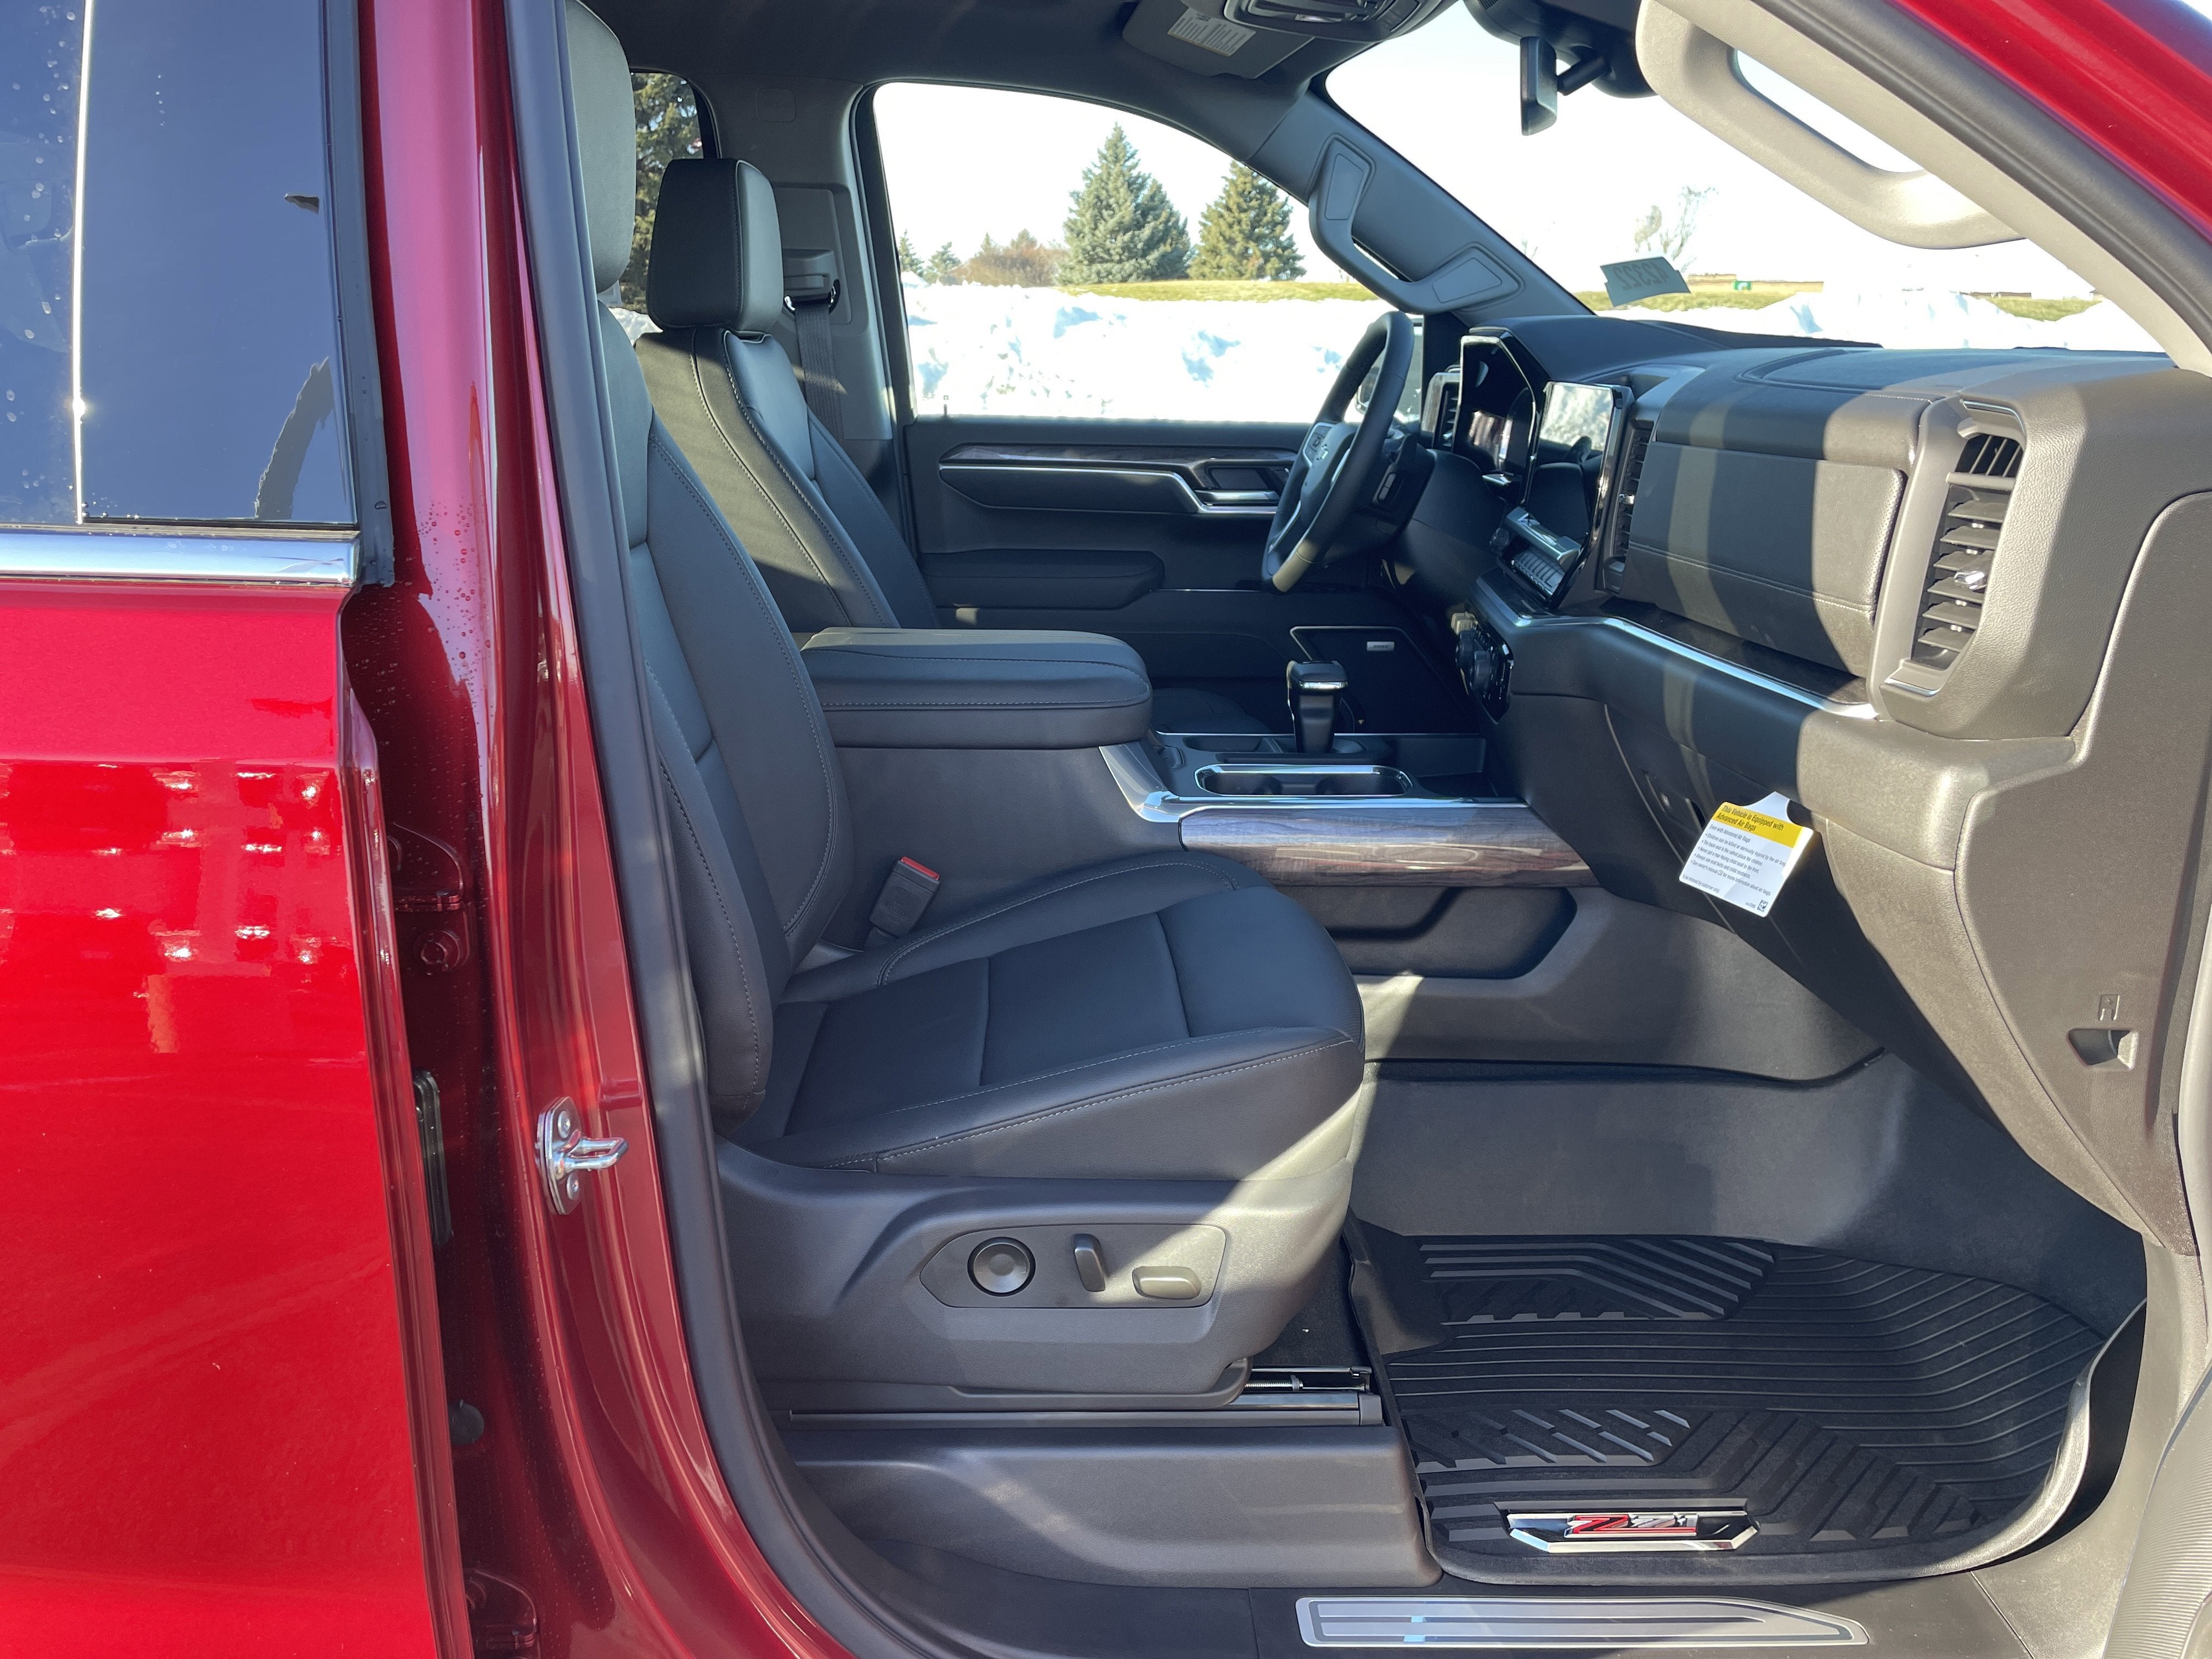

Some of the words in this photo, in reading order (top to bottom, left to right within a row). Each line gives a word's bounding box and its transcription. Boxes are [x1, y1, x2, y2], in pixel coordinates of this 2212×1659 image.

[1716, 812, 1739, 825] Advanced
[1743, 822, 1757, 832] Bags
[1731, 808, 1747, 819] Vehicle
[1751, 815, 1774, 827] Equipped
